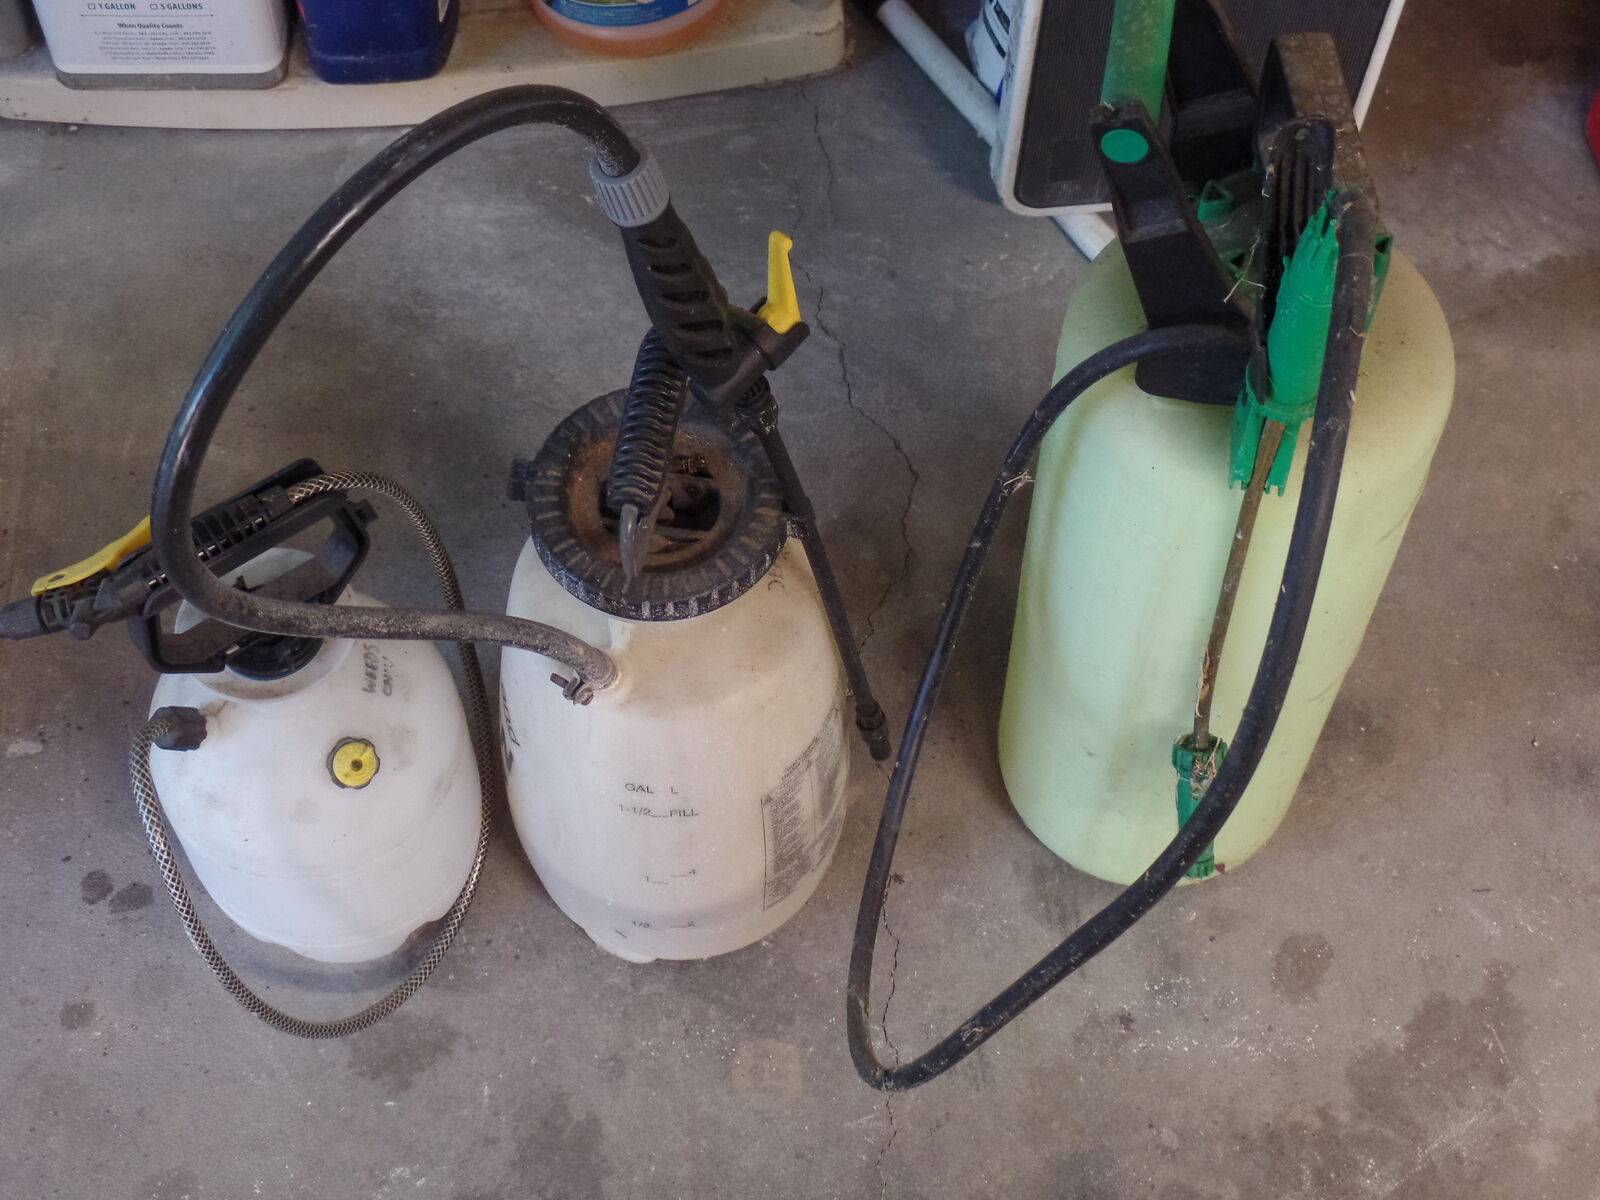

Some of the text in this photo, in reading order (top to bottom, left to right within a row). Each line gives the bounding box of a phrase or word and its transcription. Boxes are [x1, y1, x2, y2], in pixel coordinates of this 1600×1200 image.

[624, 782, 679, 795] GAL L
[618, 804, 699, 818] 1-1/2 FILL
